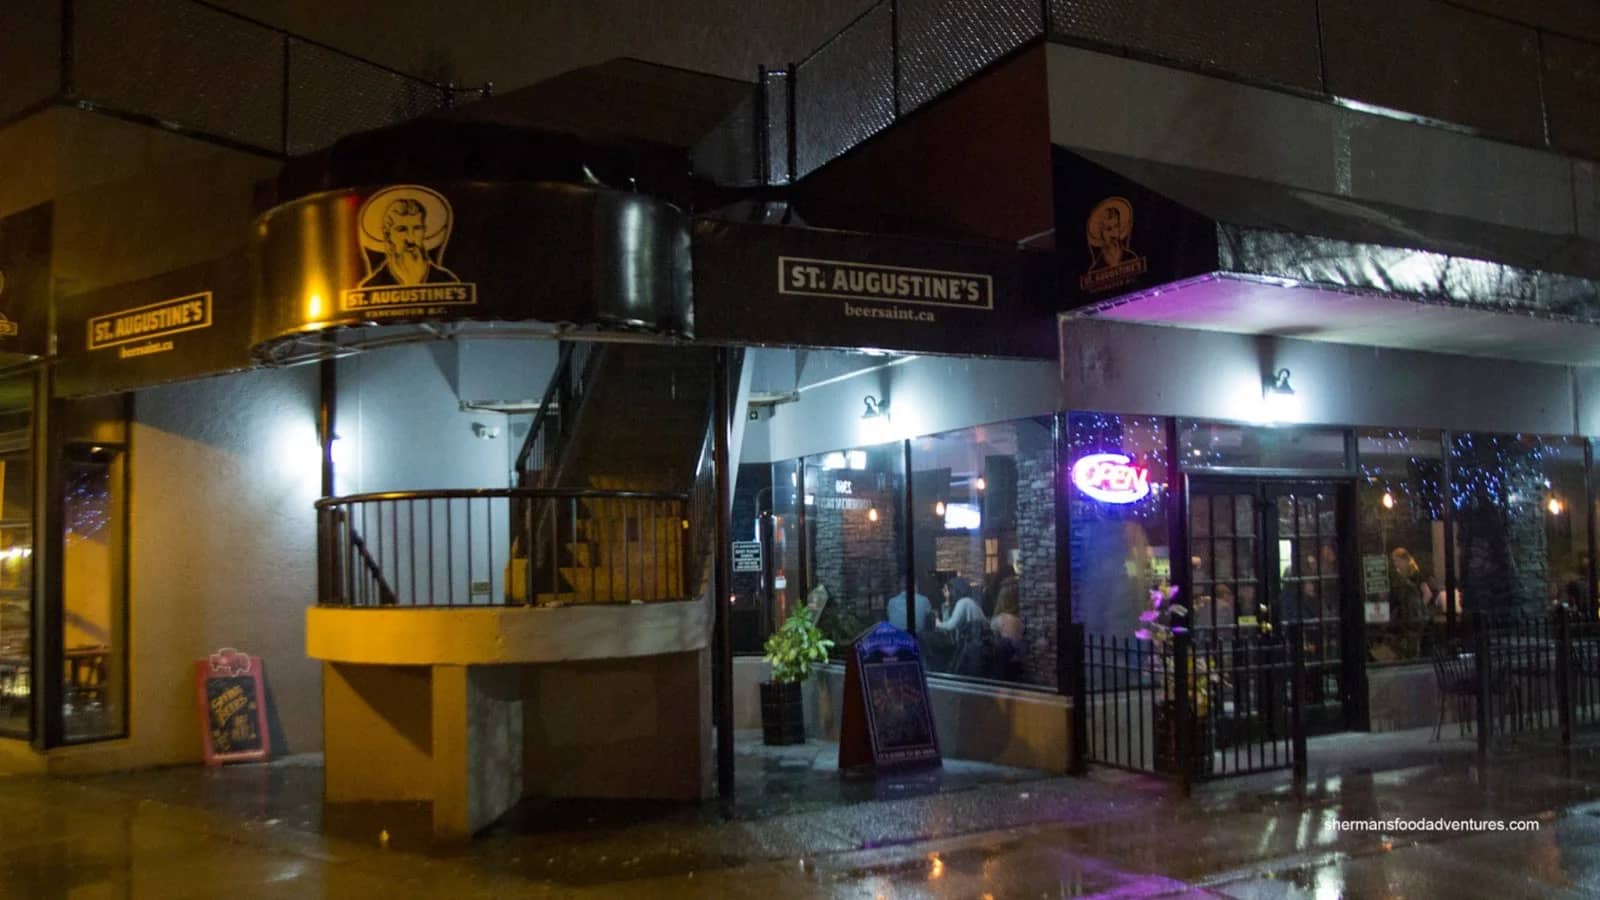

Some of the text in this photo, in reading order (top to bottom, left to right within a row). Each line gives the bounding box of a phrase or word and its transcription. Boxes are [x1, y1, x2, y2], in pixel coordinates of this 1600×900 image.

[347, 287, 467, 306] ST. AUGUSTINE'S
[791, 265, 980, 302] ST. AUGUSTINE'S
[95, 300, 203, 341] ST. AUGUSTINE'S
[844, 302, 935, 322] beersaint.ca
[1072, 453, 1150, 504] OPEN
